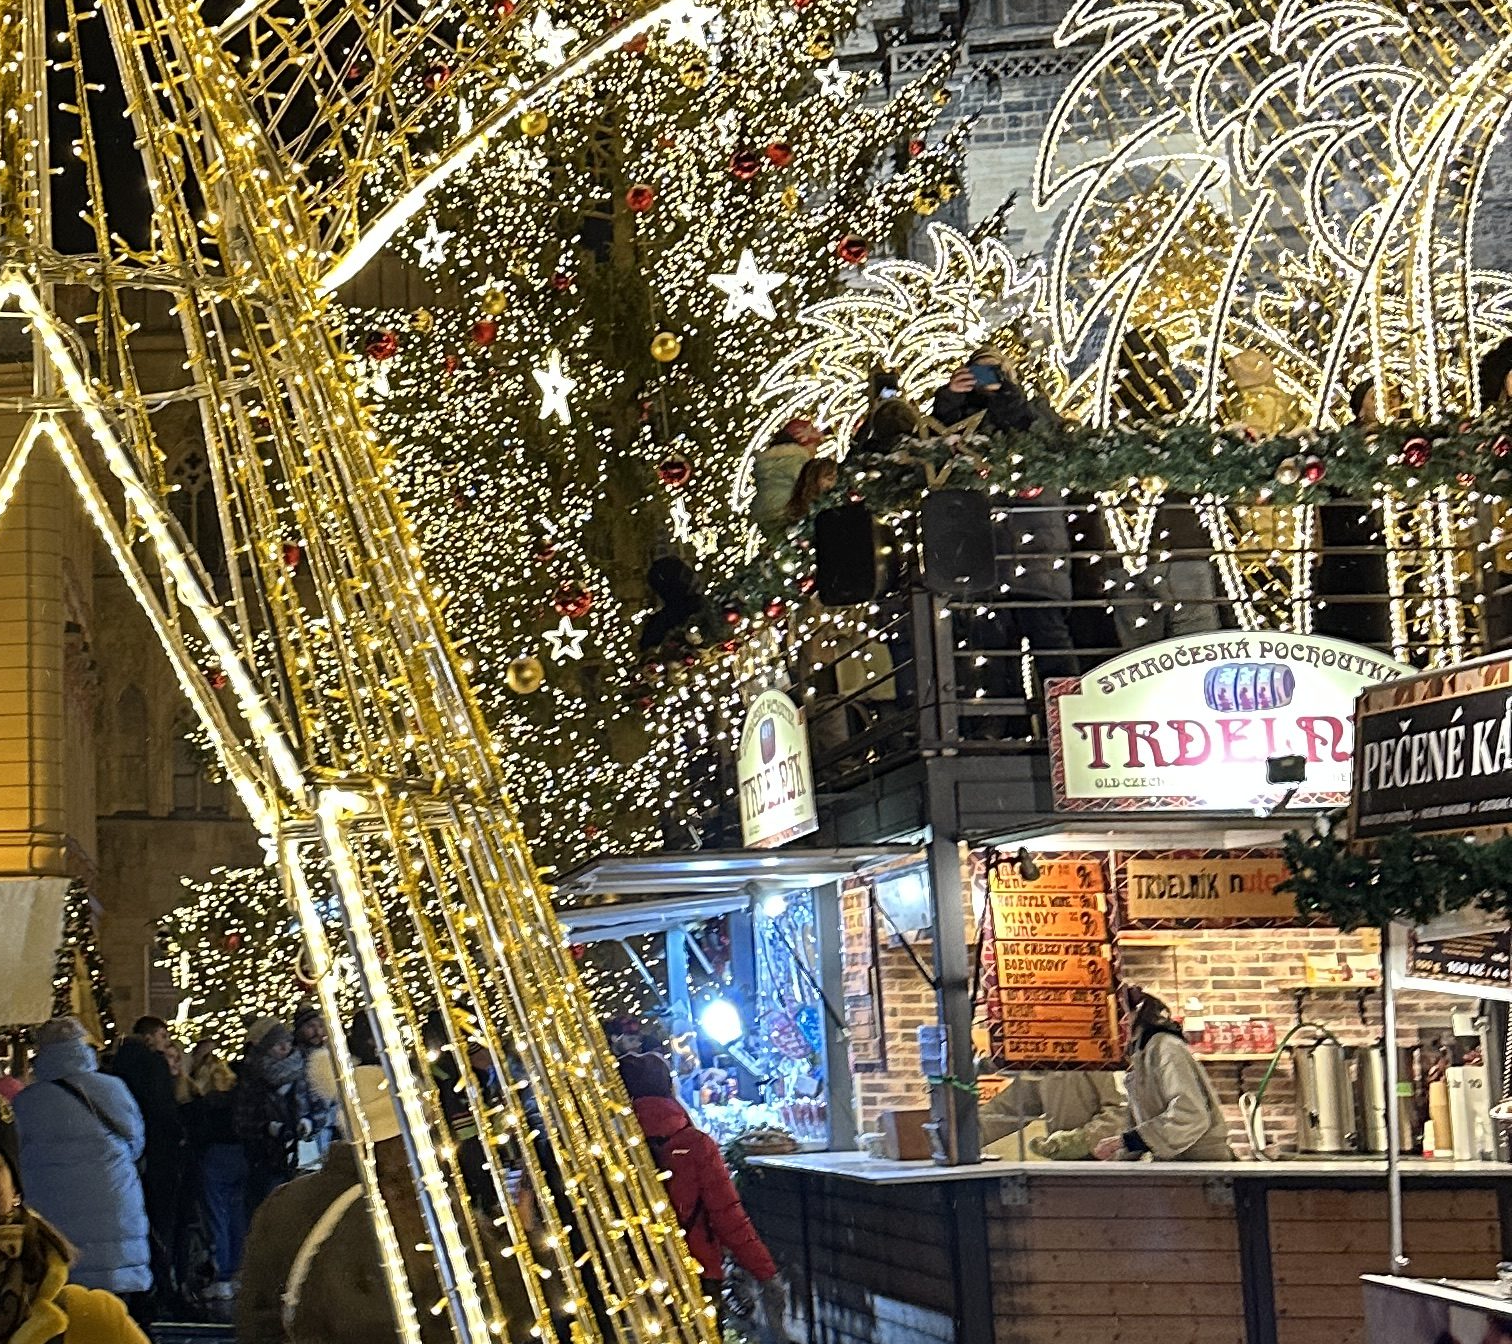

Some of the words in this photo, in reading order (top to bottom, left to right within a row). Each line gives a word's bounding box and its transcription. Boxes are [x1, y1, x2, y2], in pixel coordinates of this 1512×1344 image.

[1096, 637, 1252, 695] STAROČESKÁ
[1072, 715, 1353, 769] TRDELN
[1361, 705, 1466, 792] PEČENÉ
[1132, 868, 1220, 900] TRDELNÍK
